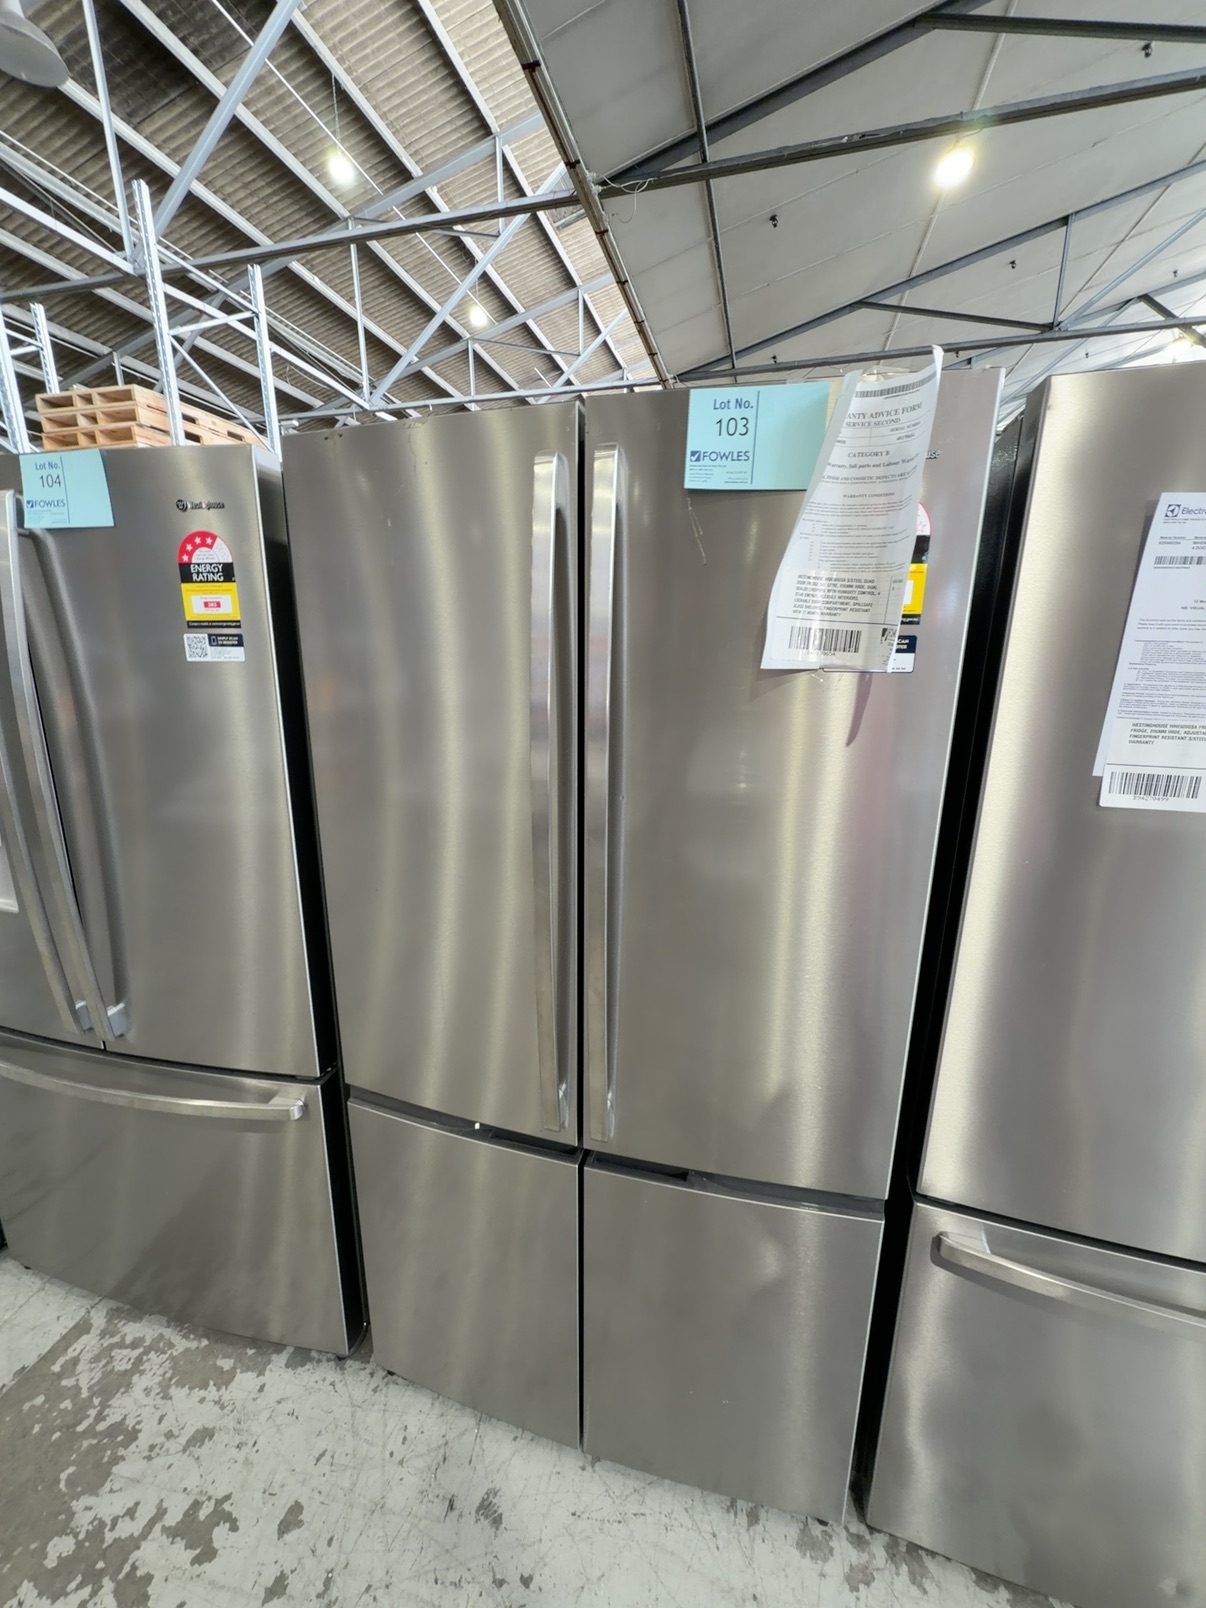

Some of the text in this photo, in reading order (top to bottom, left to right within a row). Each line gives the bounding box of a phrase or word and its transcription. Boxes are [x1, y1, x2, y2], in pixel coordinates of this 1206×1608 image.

[713, 398, 754, 410] Lot No.
[868, 408, 900, 419] ADVICE
[716, 417, 749, 436] 103
[873, 417, 901, 427] SECOND
[702, 451, 750, 461] FOWLES
[35, 461, 60, 470] Lot No.
[40, 474, 61, 488] 104
[35, 499, 65, 508] FOWLES
[190, 564, 223, 573] ENERGY
[192, 573, 224, 582] RATING
